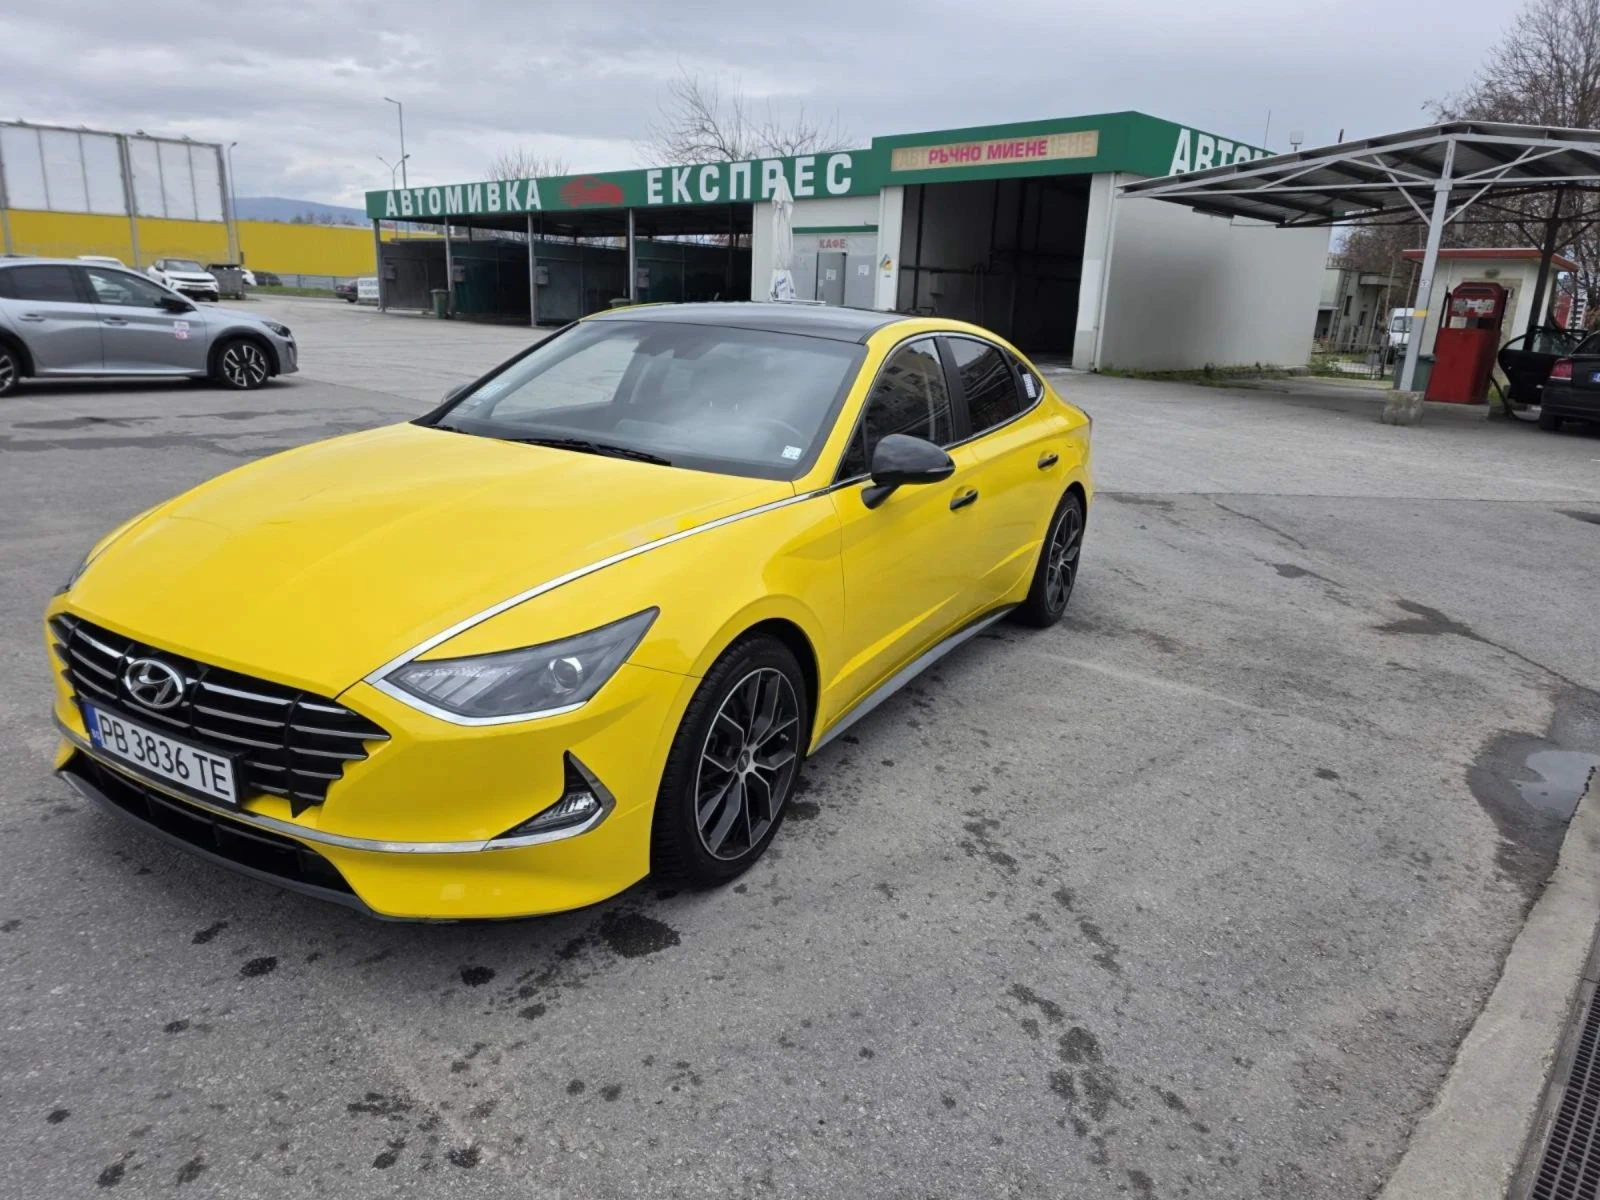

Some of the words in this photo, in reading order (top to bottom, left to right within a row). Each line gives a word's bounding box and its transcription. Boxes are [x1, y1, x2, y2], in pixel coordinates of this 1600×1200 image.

[928, 146, 981, 165] РЪЧНО
[987, 140, 1048, 159] МИЕНЕ
[1169, 128, 1280, 177] АВТ
[385, 179, 542, 217] АВТОМИВКА
[646, 153, 853, 205] ЕКСПРЕС
[818, 238, 846, 249] КАФЕ
[131, 729, 190, 780] 3836
